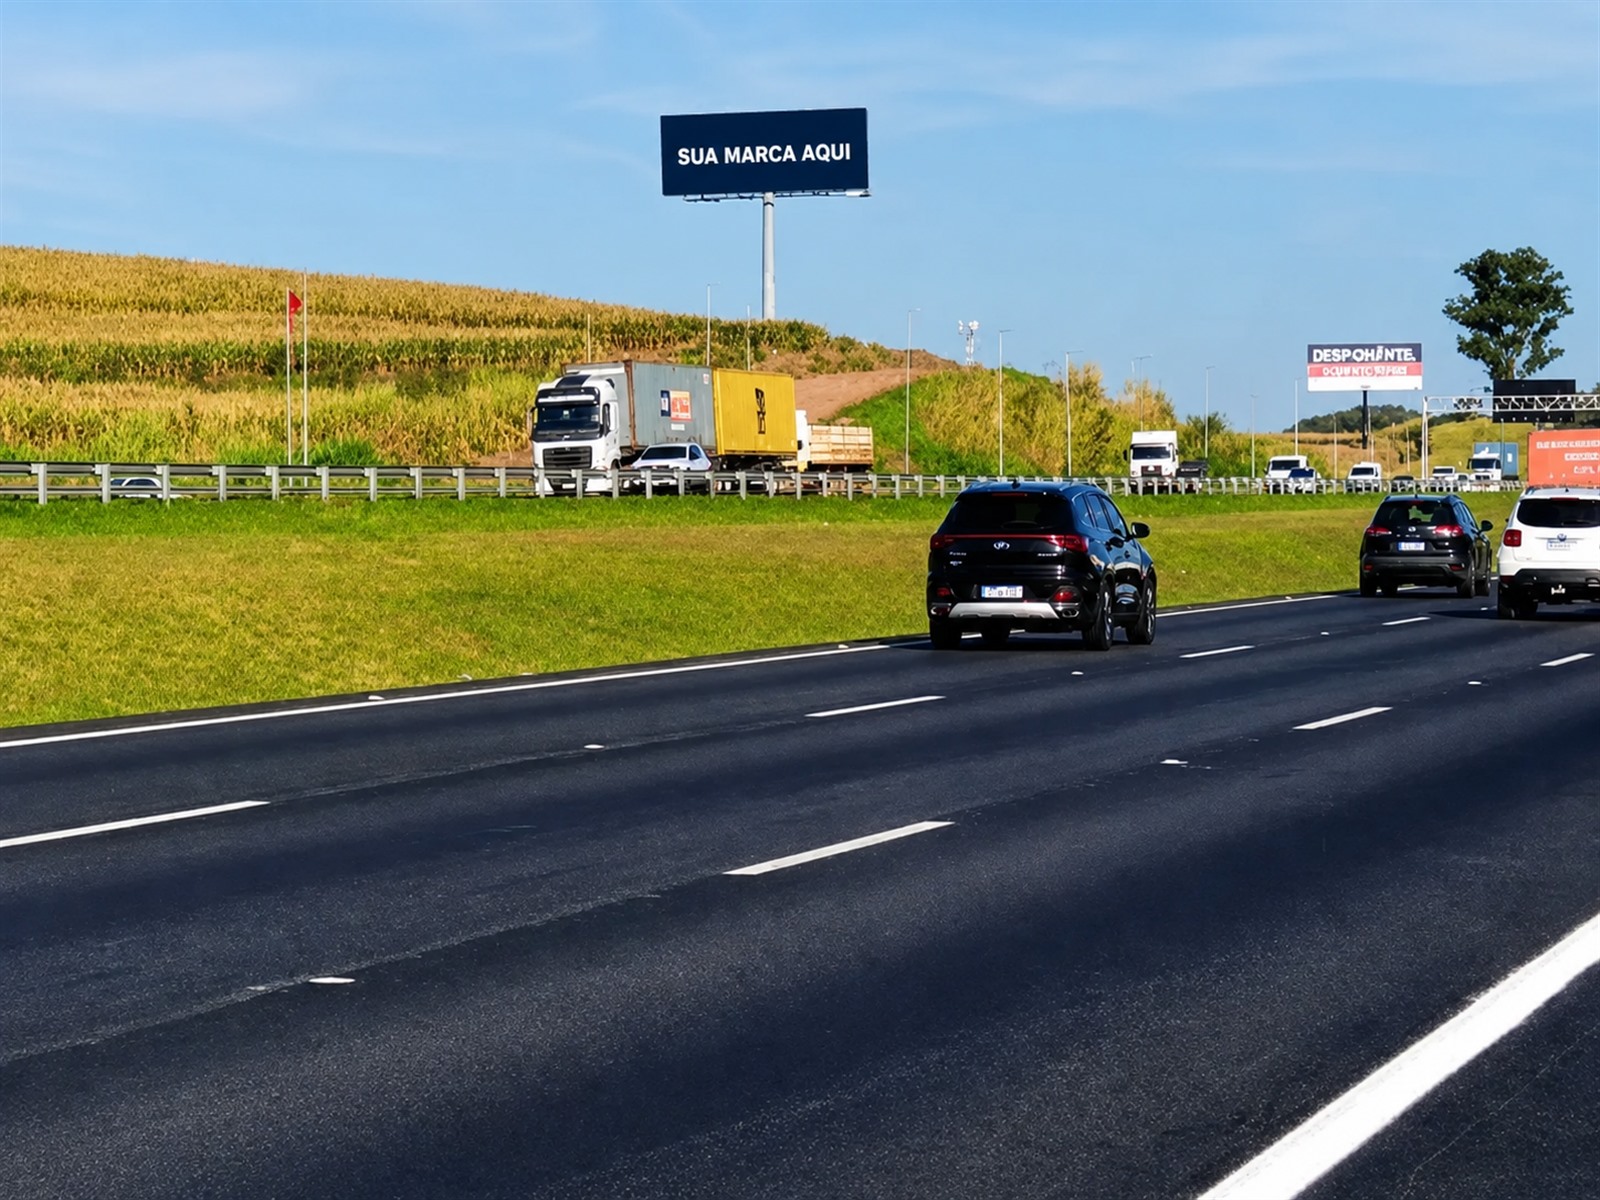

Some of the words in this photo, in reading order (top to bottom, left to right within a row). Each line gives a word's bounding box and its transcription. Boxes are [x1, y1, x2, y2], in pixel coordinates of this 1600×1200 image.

[677, 147, 719, 166] SUA
[724, 144, 797, 164] MARCA
[801, 143, 851, 163] AQUI
